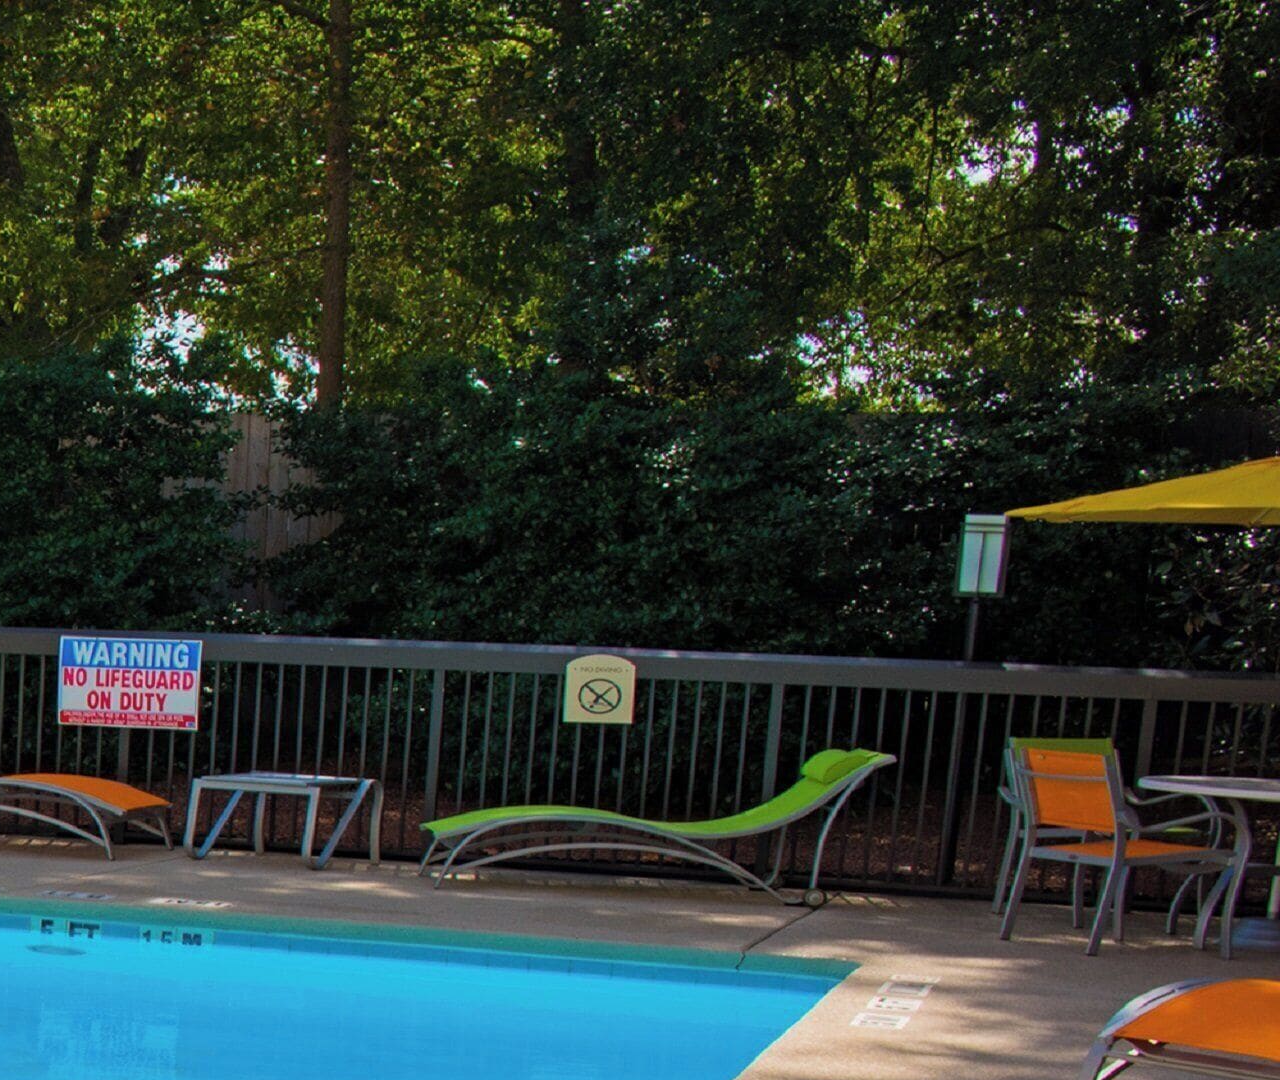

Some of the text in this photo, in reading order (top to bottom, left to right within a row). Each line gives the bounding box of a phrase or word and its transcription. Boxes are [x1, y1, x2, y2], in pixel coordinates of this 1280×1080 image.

[72, 640, 190, 668] WARNING
[63, 667, 194, 691] NO LIFEGUARD
[86, 690, 168, 712] ON DUTY
[68, 920, 101, 939] FT
[181, 931, 203, 947] M
